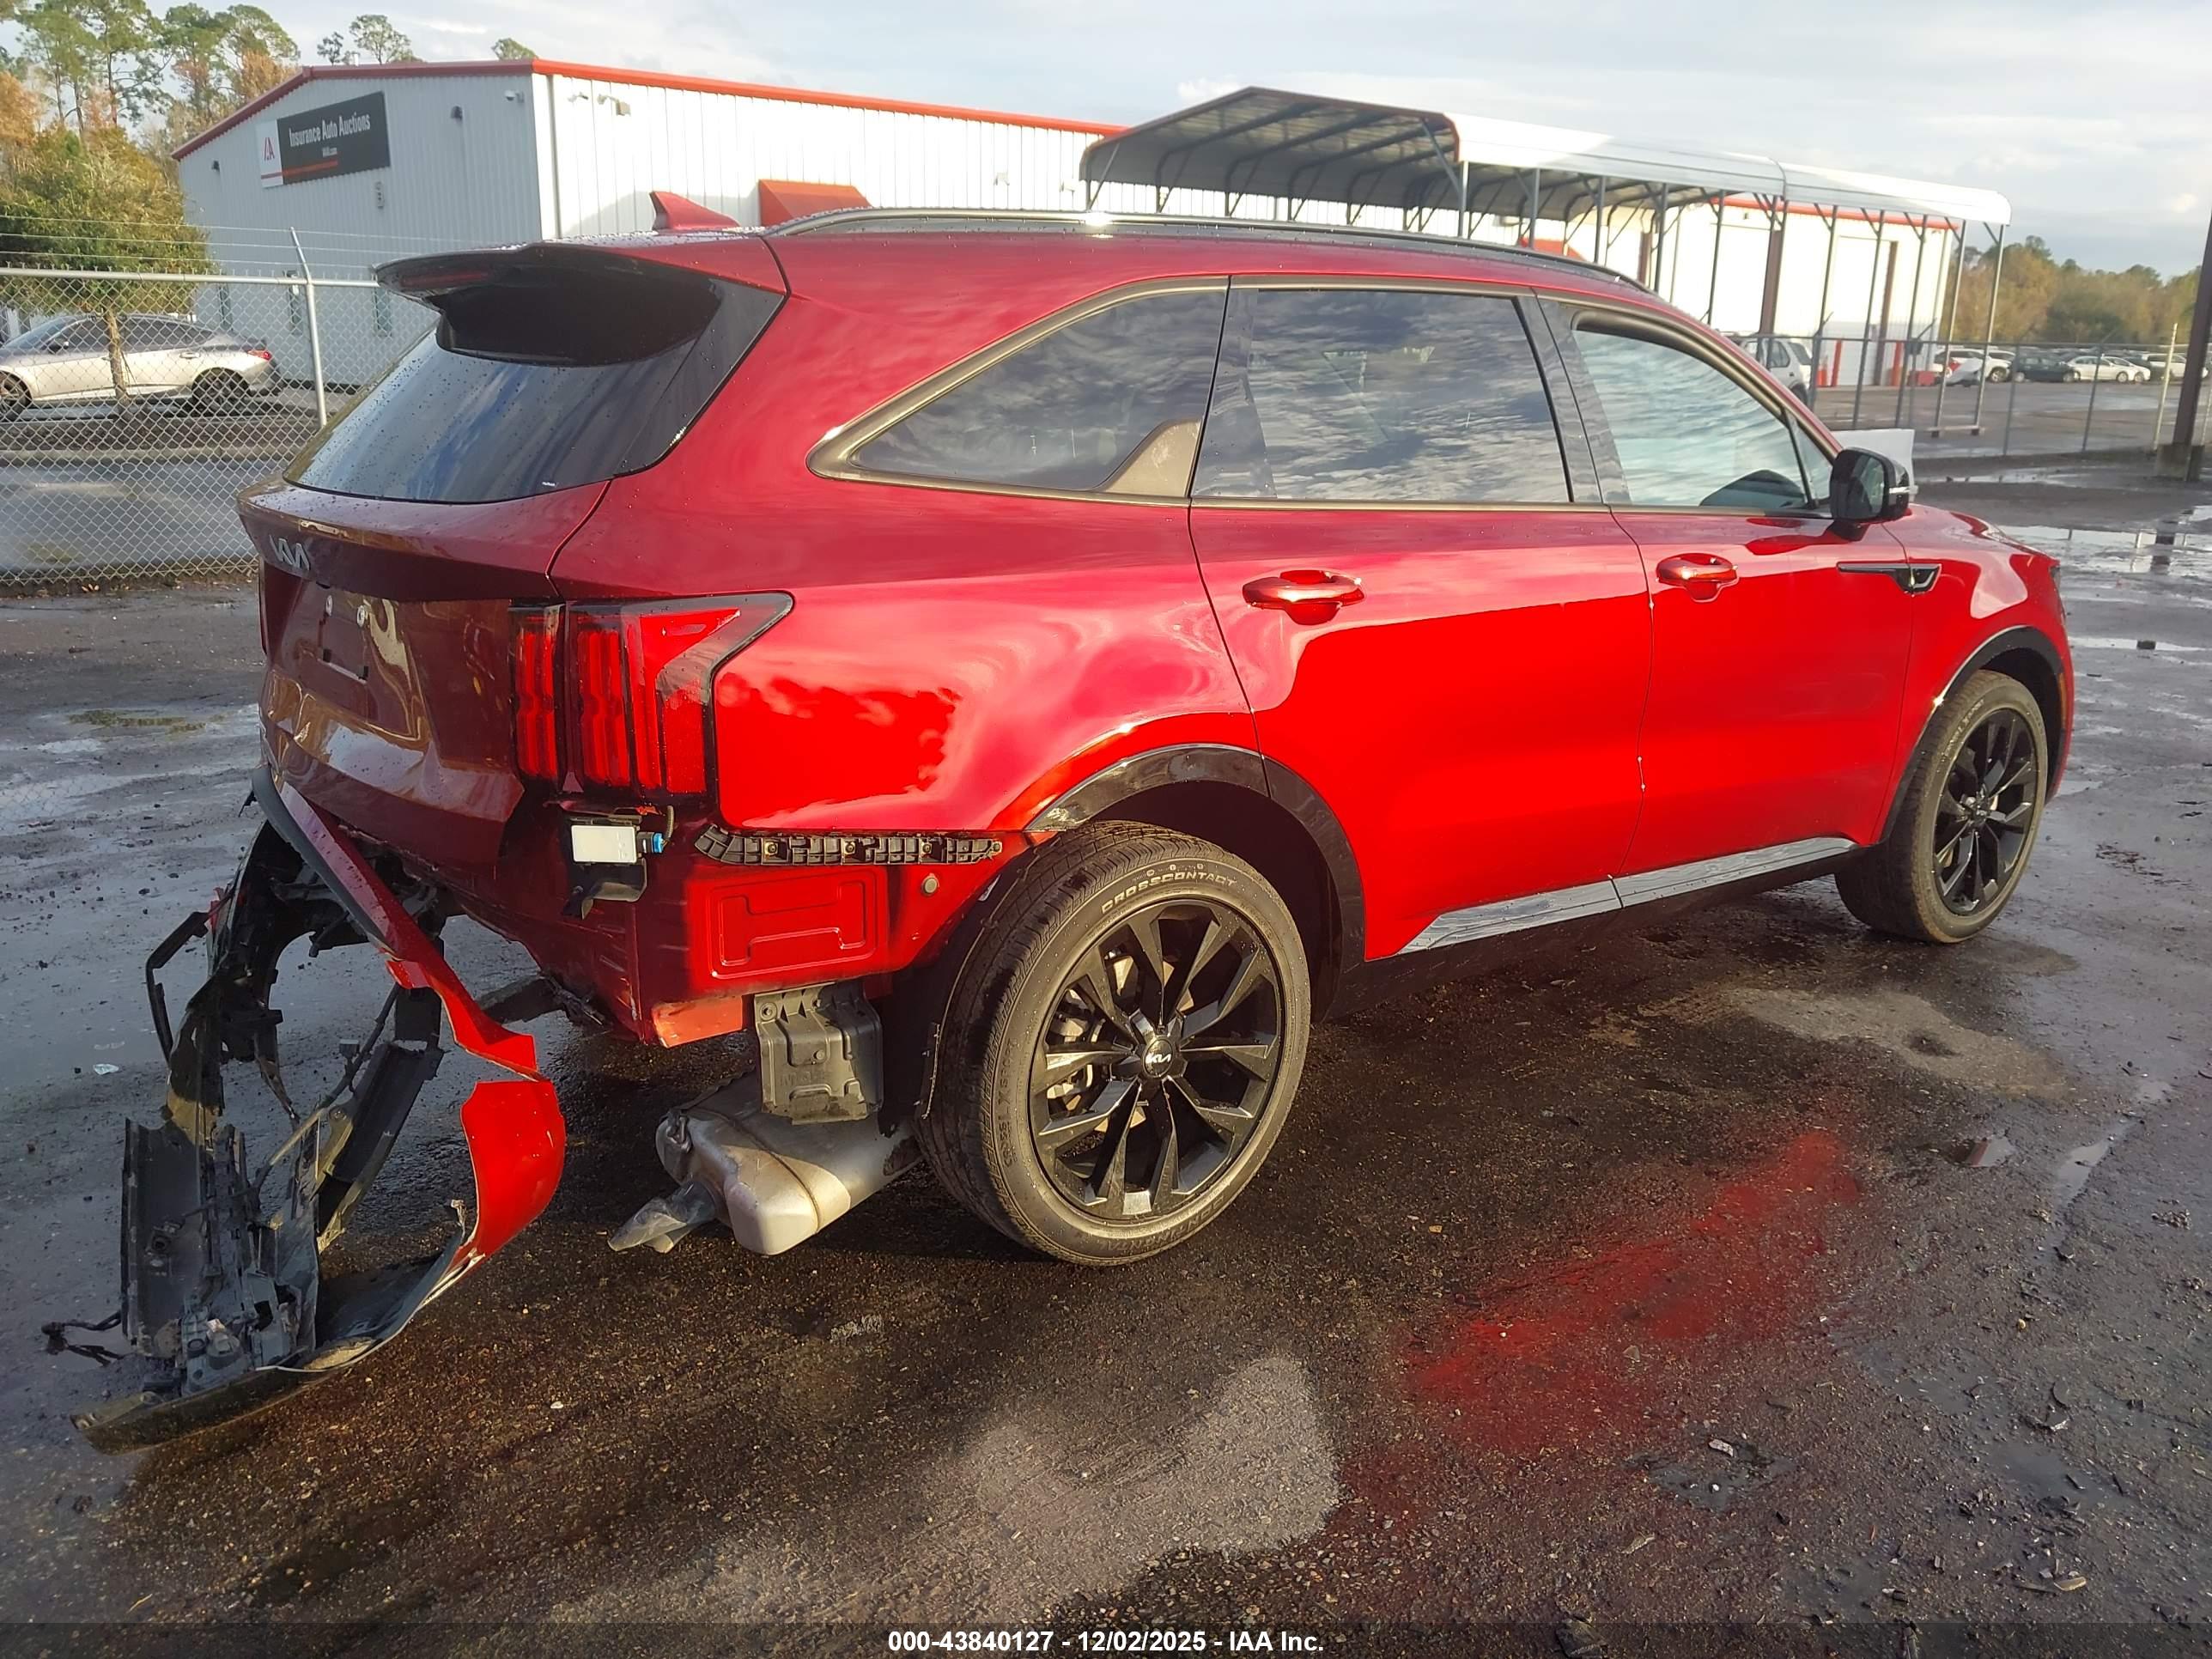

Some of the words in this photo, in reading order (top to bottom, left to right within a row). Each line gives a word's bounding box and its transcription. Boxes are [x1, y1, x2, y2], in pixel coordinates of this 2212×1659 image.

[289, 126, 321, 148] Insurance
[322, 118, 338, 141] Auto
[338, 112, 371, 137] Auctions
[1101, 871, 1237, 915] CROSSCONTACT
[1145, 1052, 1172, 1064] KIA
